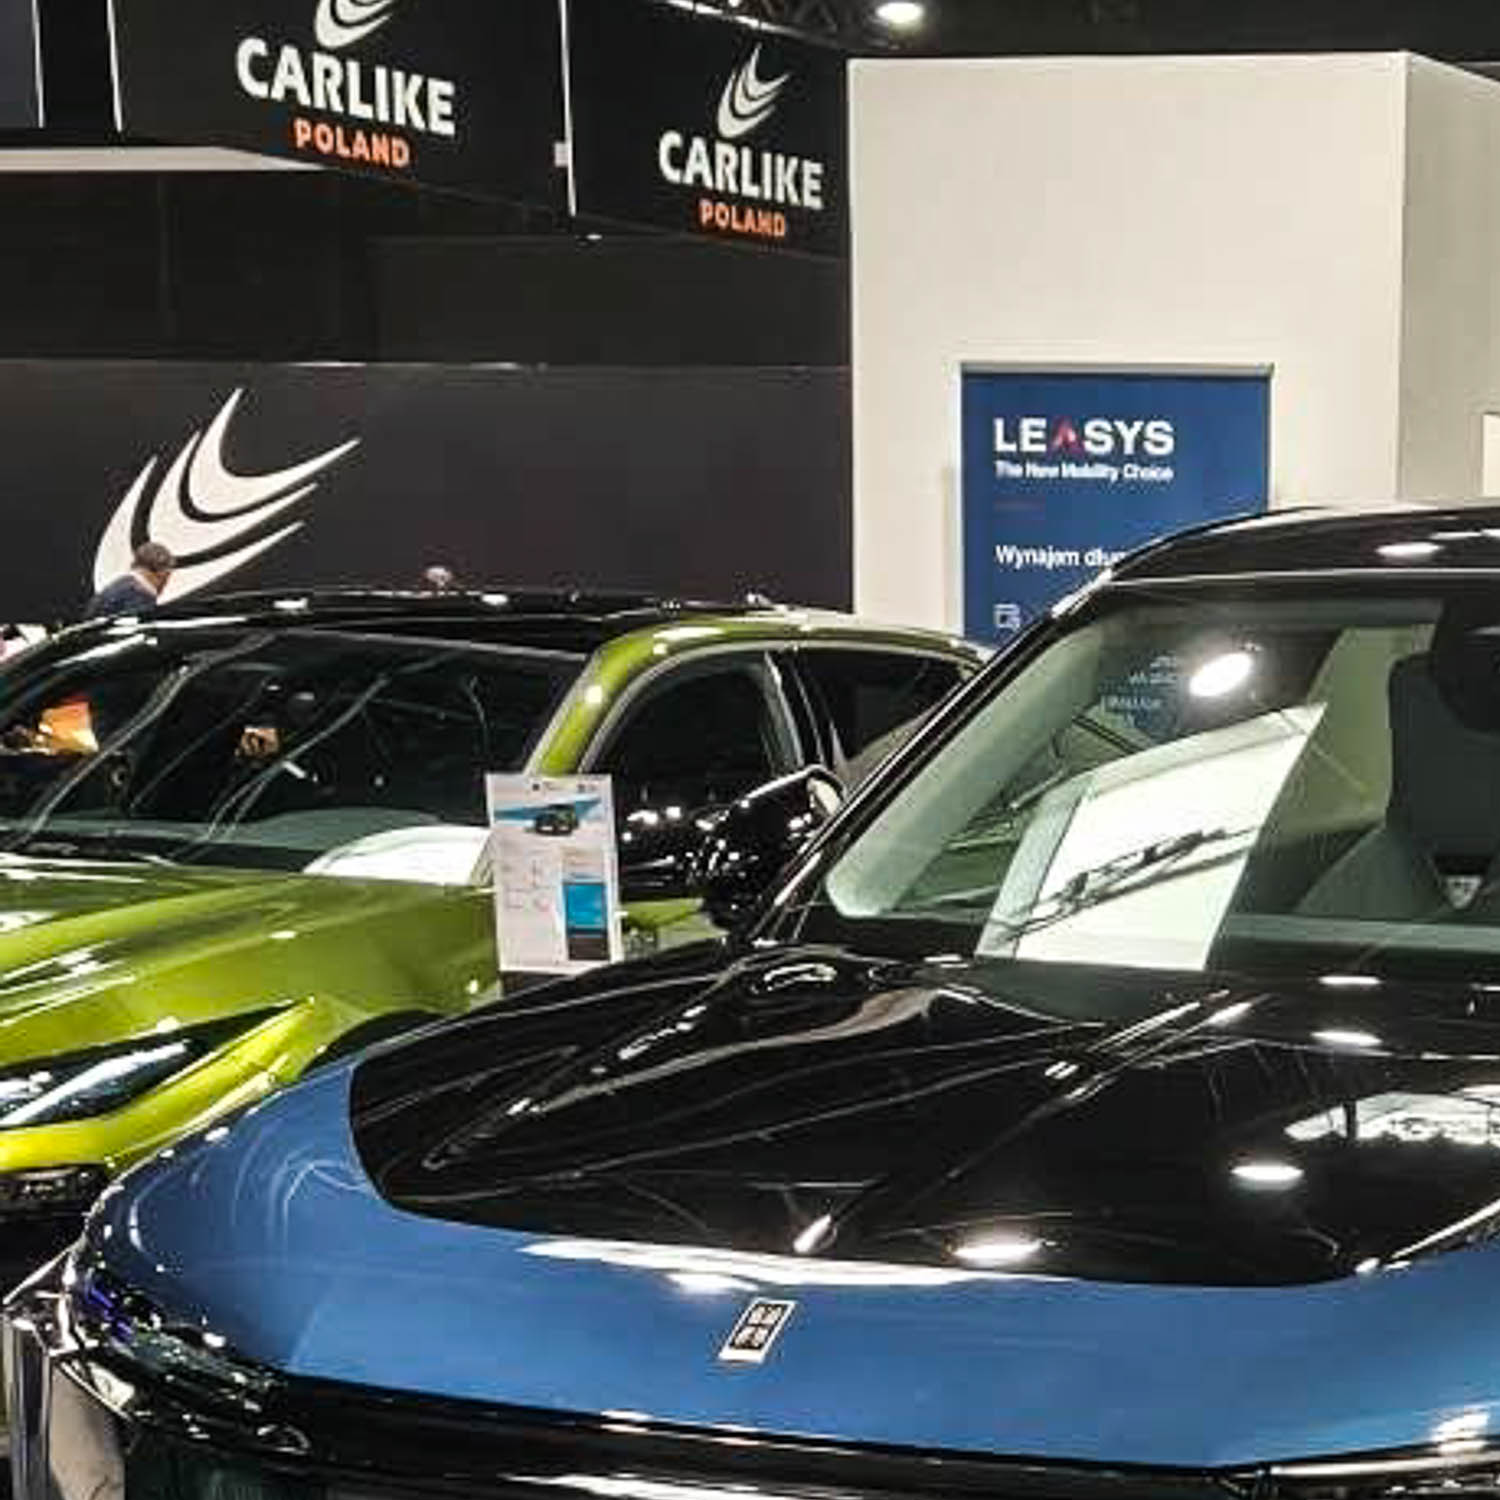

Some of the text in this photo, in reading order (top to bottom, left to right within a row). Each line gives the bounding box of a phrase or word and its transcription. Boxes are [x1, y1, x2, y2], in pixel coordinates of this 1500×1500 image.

[237, 38, 455, 135] CARLIKE
[293, 117, 410, 167] POLAND
[659, 130, 824, 209] CARLIKE
[700, 199, 786, 237] POLAND
[994, 417, 1175, 456] LEASYS
[995, 460, 1174, 482] The New Mobility Choice
[996, 544, 1079, 569] Wynajem
